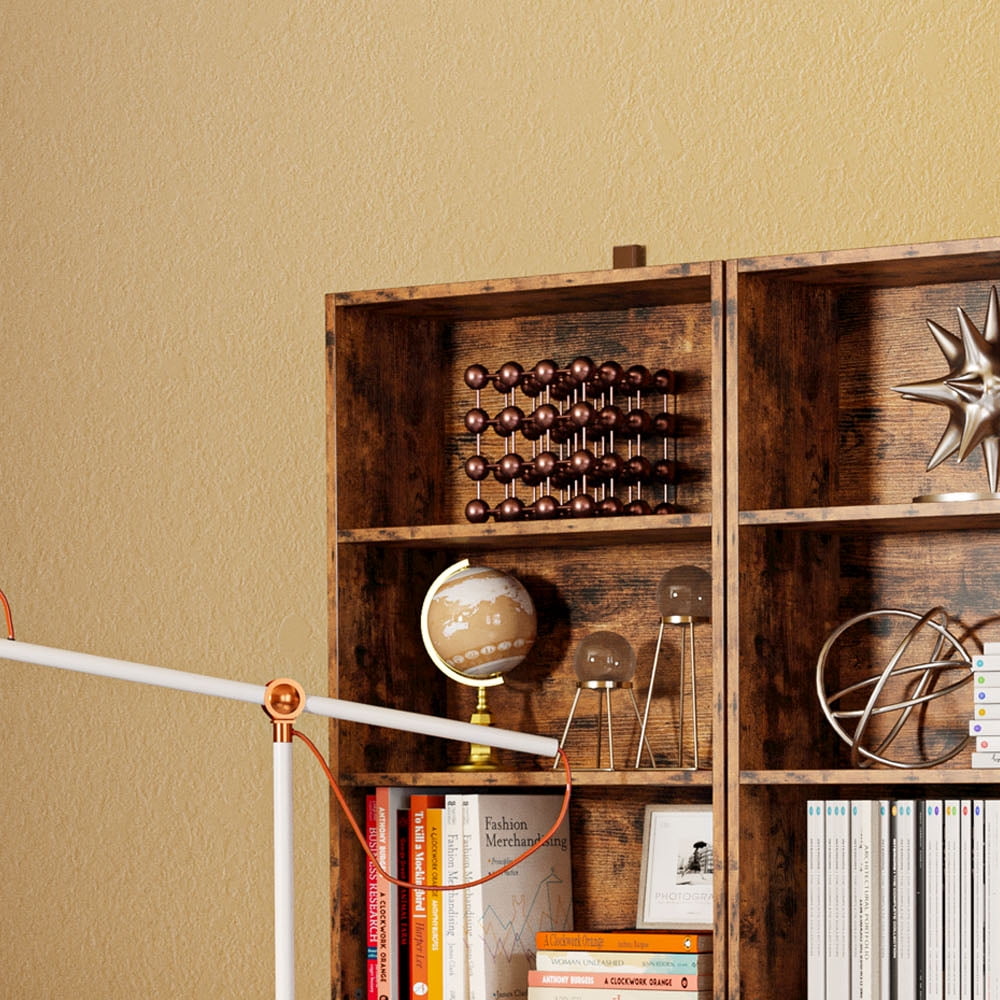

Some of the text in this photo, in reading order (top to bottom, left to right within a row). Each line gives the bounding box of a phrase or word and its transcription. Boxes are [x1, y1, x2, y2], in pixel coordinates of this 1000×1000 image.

[414, 811, 424, 823] To
[485, 816, 528, 830] Fashion
[414, 825, 425, 842] Kill
[415, 922, 425, 968] Harper Lee
[543, 935, 605, 948] A Clockwork Orange
[551, 958, 624, 967] WOMAN UNLEASHED
[542, 975, 594, 985] ANTHONY BURGESS
[604, 977, 672, 987] A CLOCKWORK ORANGE
